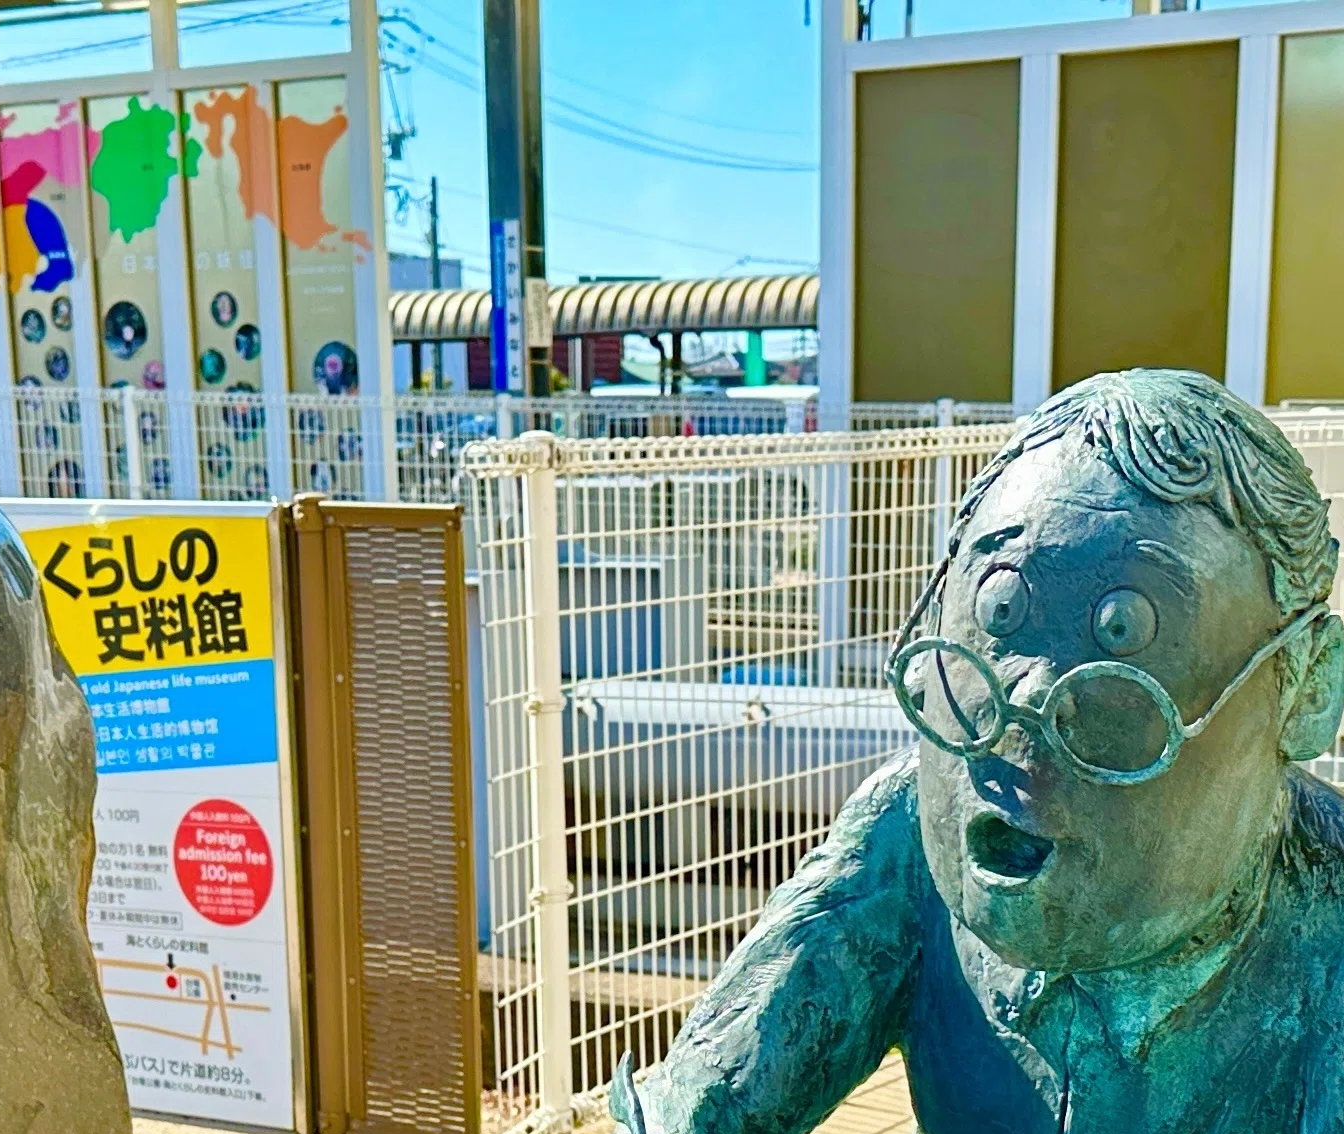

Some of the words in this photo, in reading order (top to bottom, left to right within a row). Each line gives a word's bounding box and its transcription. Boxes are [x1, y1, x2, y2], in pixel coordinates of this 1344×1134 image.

[44, 528, 220, 600] くらしの
[93, 589, 248, 664] 史料館
[90, 682, 111, 695] old
[114, 678, 170, 695] Japanese
[171, 673, 193, 688] life
[194, 671, 250, 686] museum
[195, 828, 246, 848] Foreign
[178, 845, 243, 864] admission
[245, 849, 268, 866] fee
[199, 865, 227, 881] 100
[227, 870, 249, 886] yen
